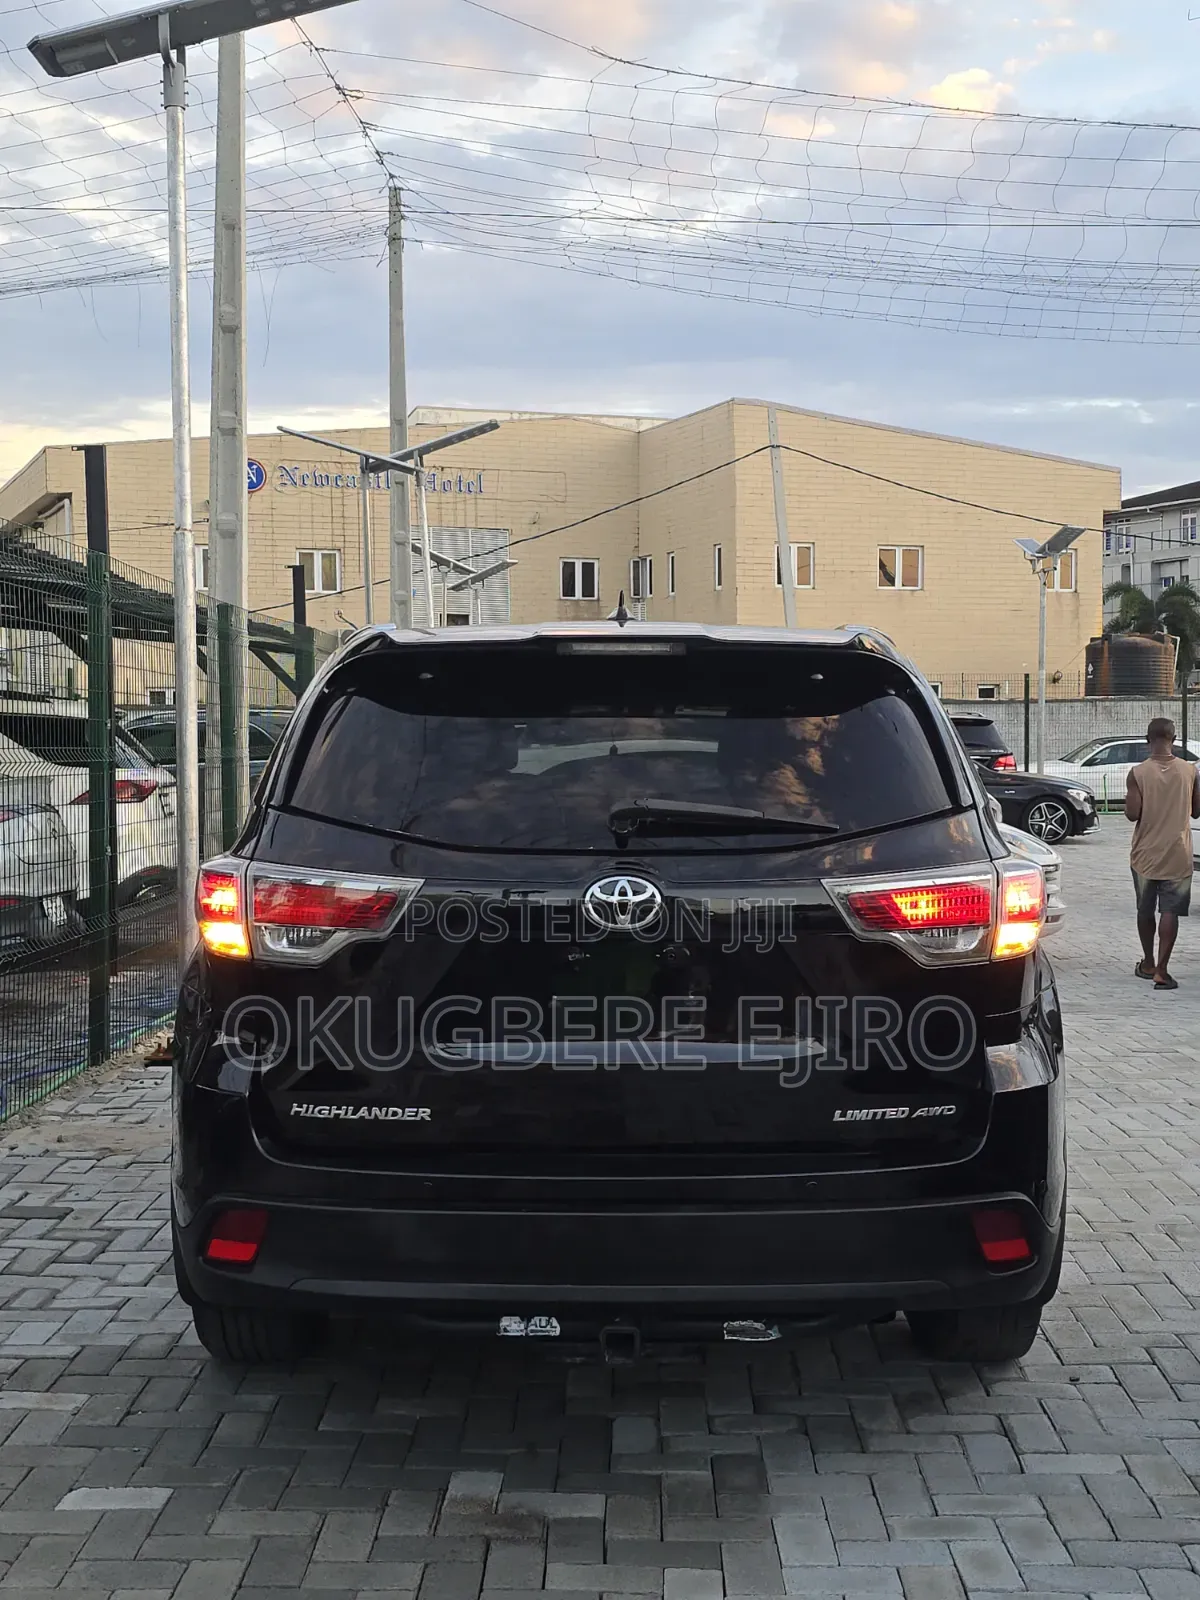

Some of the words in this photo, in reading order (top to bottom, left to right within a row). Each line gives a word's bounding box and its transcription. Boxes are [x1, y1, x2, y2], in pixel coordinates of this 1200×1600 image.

[277, 464, 392, 490] Newcatl
[290, 1103, 432, 1121] HIGHLANDER
[832, 1107, 910, 1121] LIMITED
[911, 1105, 957, 1118] AWD
